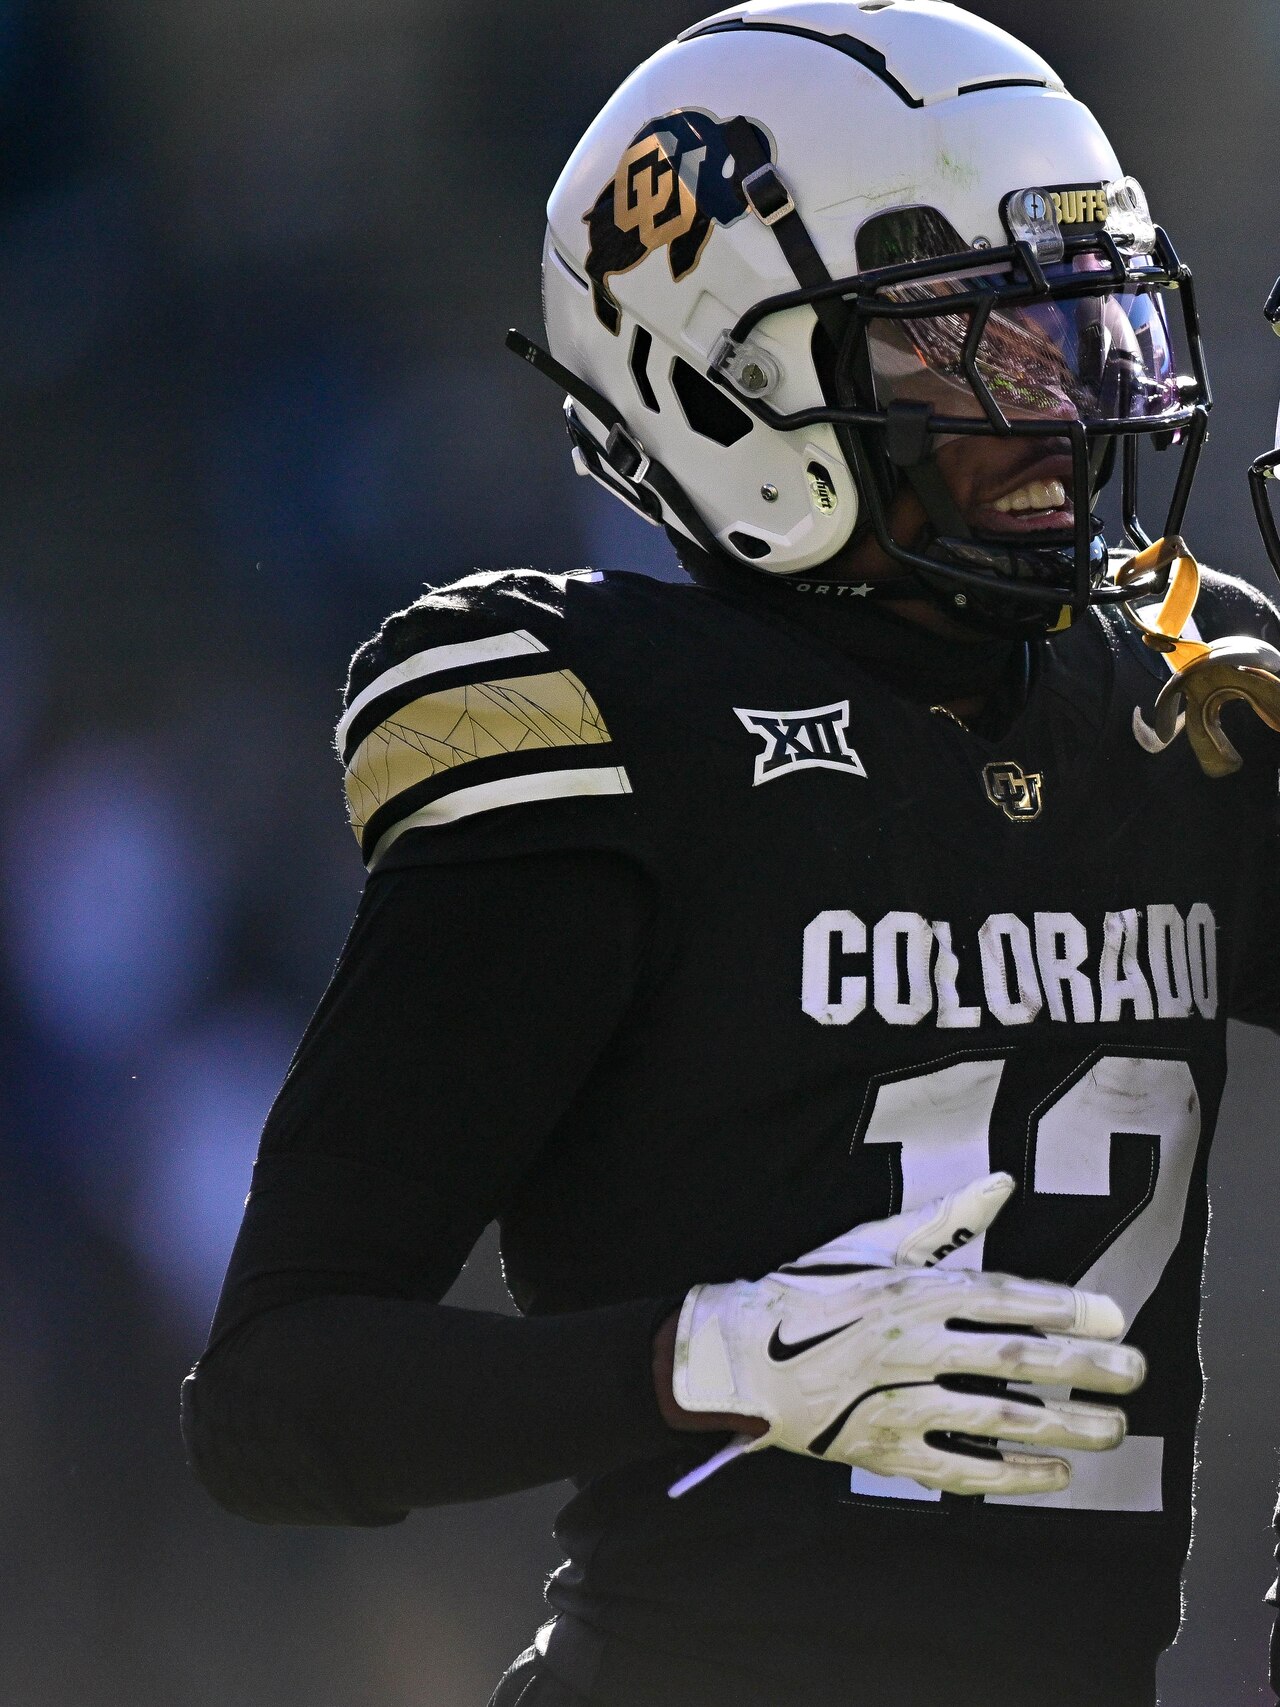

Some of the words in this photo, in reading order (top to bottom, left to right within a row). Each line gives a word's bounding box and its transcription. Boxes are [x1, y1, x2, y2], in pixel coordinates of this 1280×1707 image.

[614, 131, 706, 250] CU
[1048, 189, 1109, 224] BUFFS
[746, 711, 859, 777] XII
[982, 760, 1045, 823] CU
[801, 902, 1219, 1029] COLORADO
[849, 1056, 1202, 1512] 12
